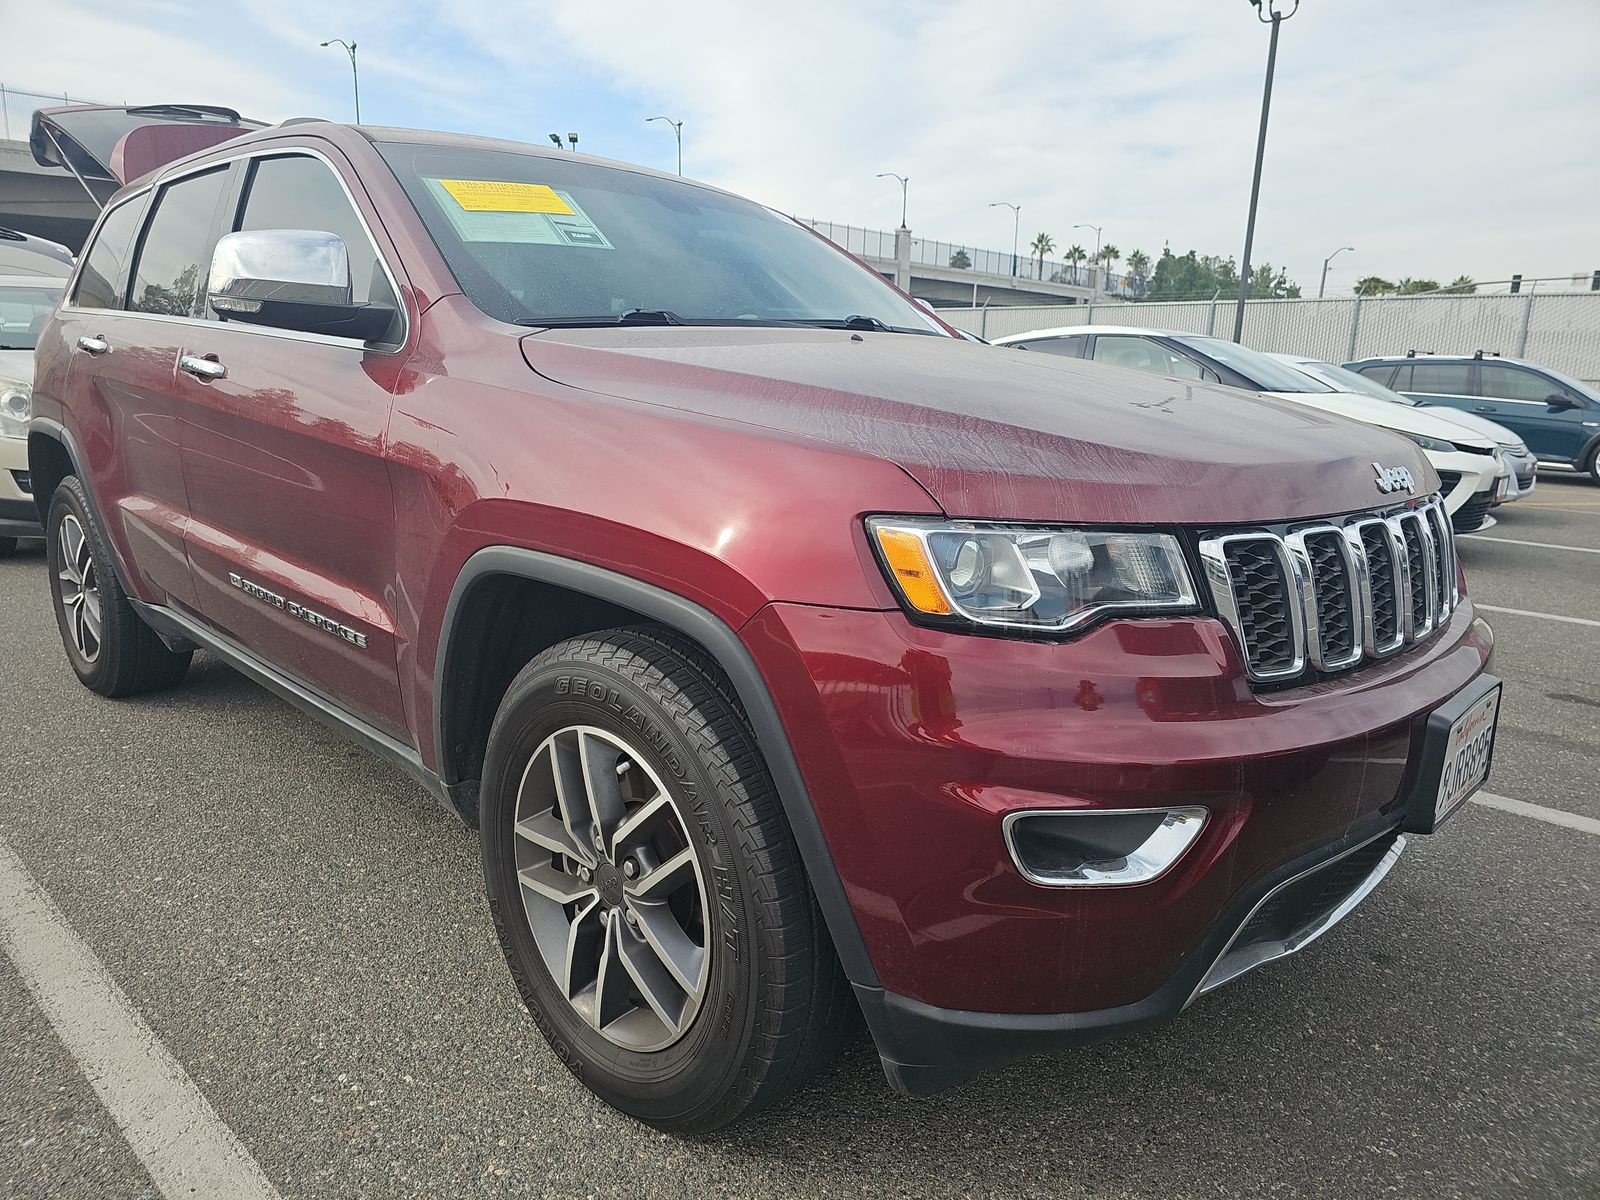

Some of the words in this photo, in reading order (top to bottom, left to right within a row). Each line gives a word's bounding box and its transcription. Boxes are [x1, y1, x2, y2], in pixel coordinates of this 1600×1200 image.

[1371, 462, 1415, 495] Jeep
[241, 578, 287, 610] GRAND
[286, 600, 369, 650] CHEROKEE
[553, 675, 718, 846] GEOLANDAR
[1438, 725, 1493, 810] 9JRB895
